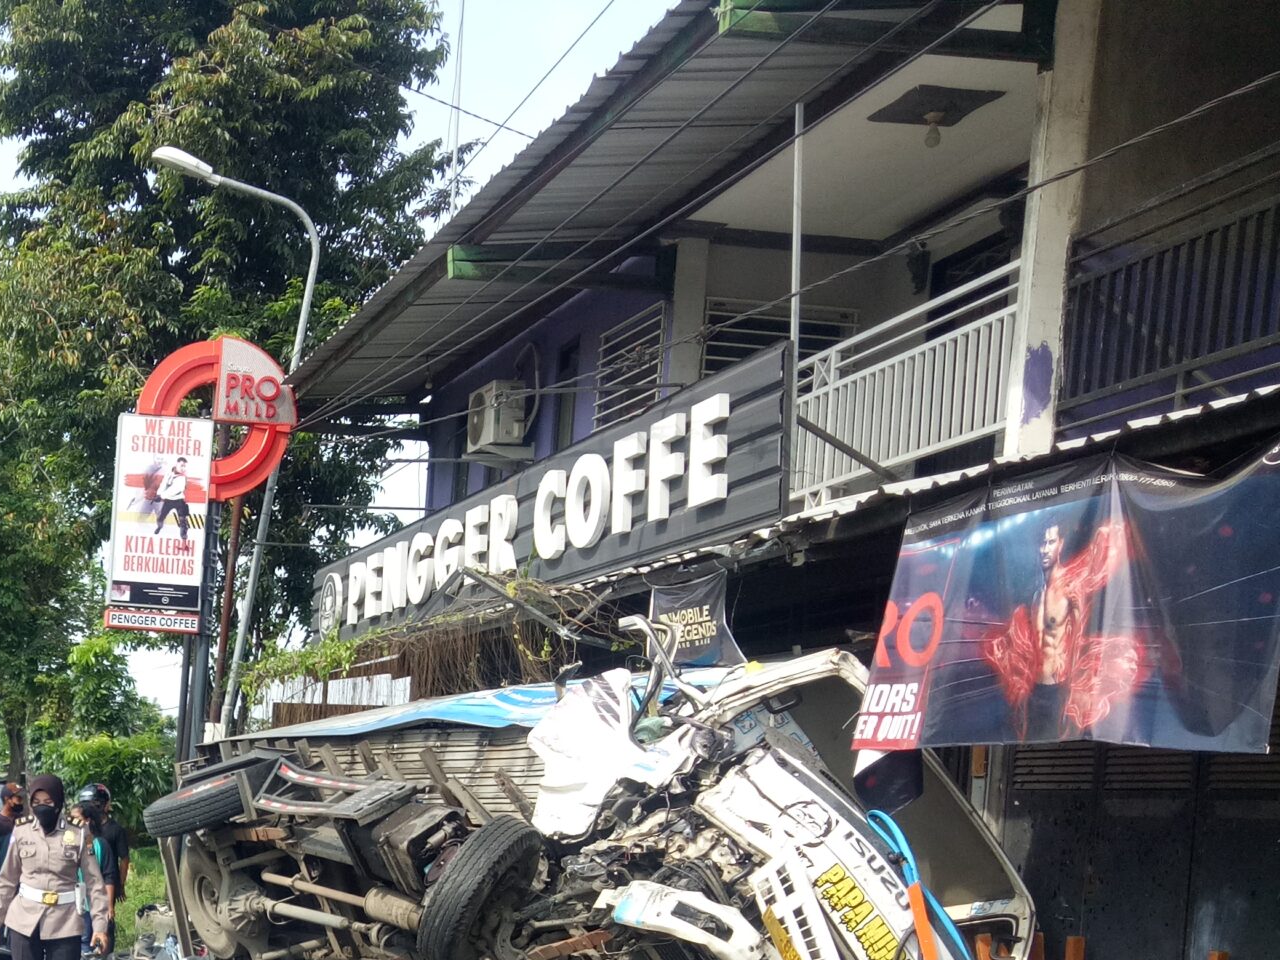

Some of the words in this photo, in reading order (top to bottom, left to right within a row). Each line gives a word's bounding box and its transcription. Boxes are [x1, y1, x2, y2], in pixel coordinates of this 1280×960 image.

[225, 373, 281, 402] PRO
[224, 400, 277, 419] MILD
[145, 418, 164, 436] WE
[168, 420, 193, 438] ARE
[131, 435, 204, 457] STRONGER.
[347, 494, 518, 625] PENGGER
[533, 393, 730, 560] COFFE
[125, 535, 154, 554] KITA
[123, 555, 195, 576] BERKUALITAS
[111, 613, 157, 626] PENGGER
[159, 617, 197, 629] COFFEE
[671, 604, 711, 625] MOBILE
[860, 682, 919, 713] IORS
[877, 711, 922, 742] QUIT!
[843, 830, 911, 912] ISUZU
[812, 862, 875, 933] PAPA
